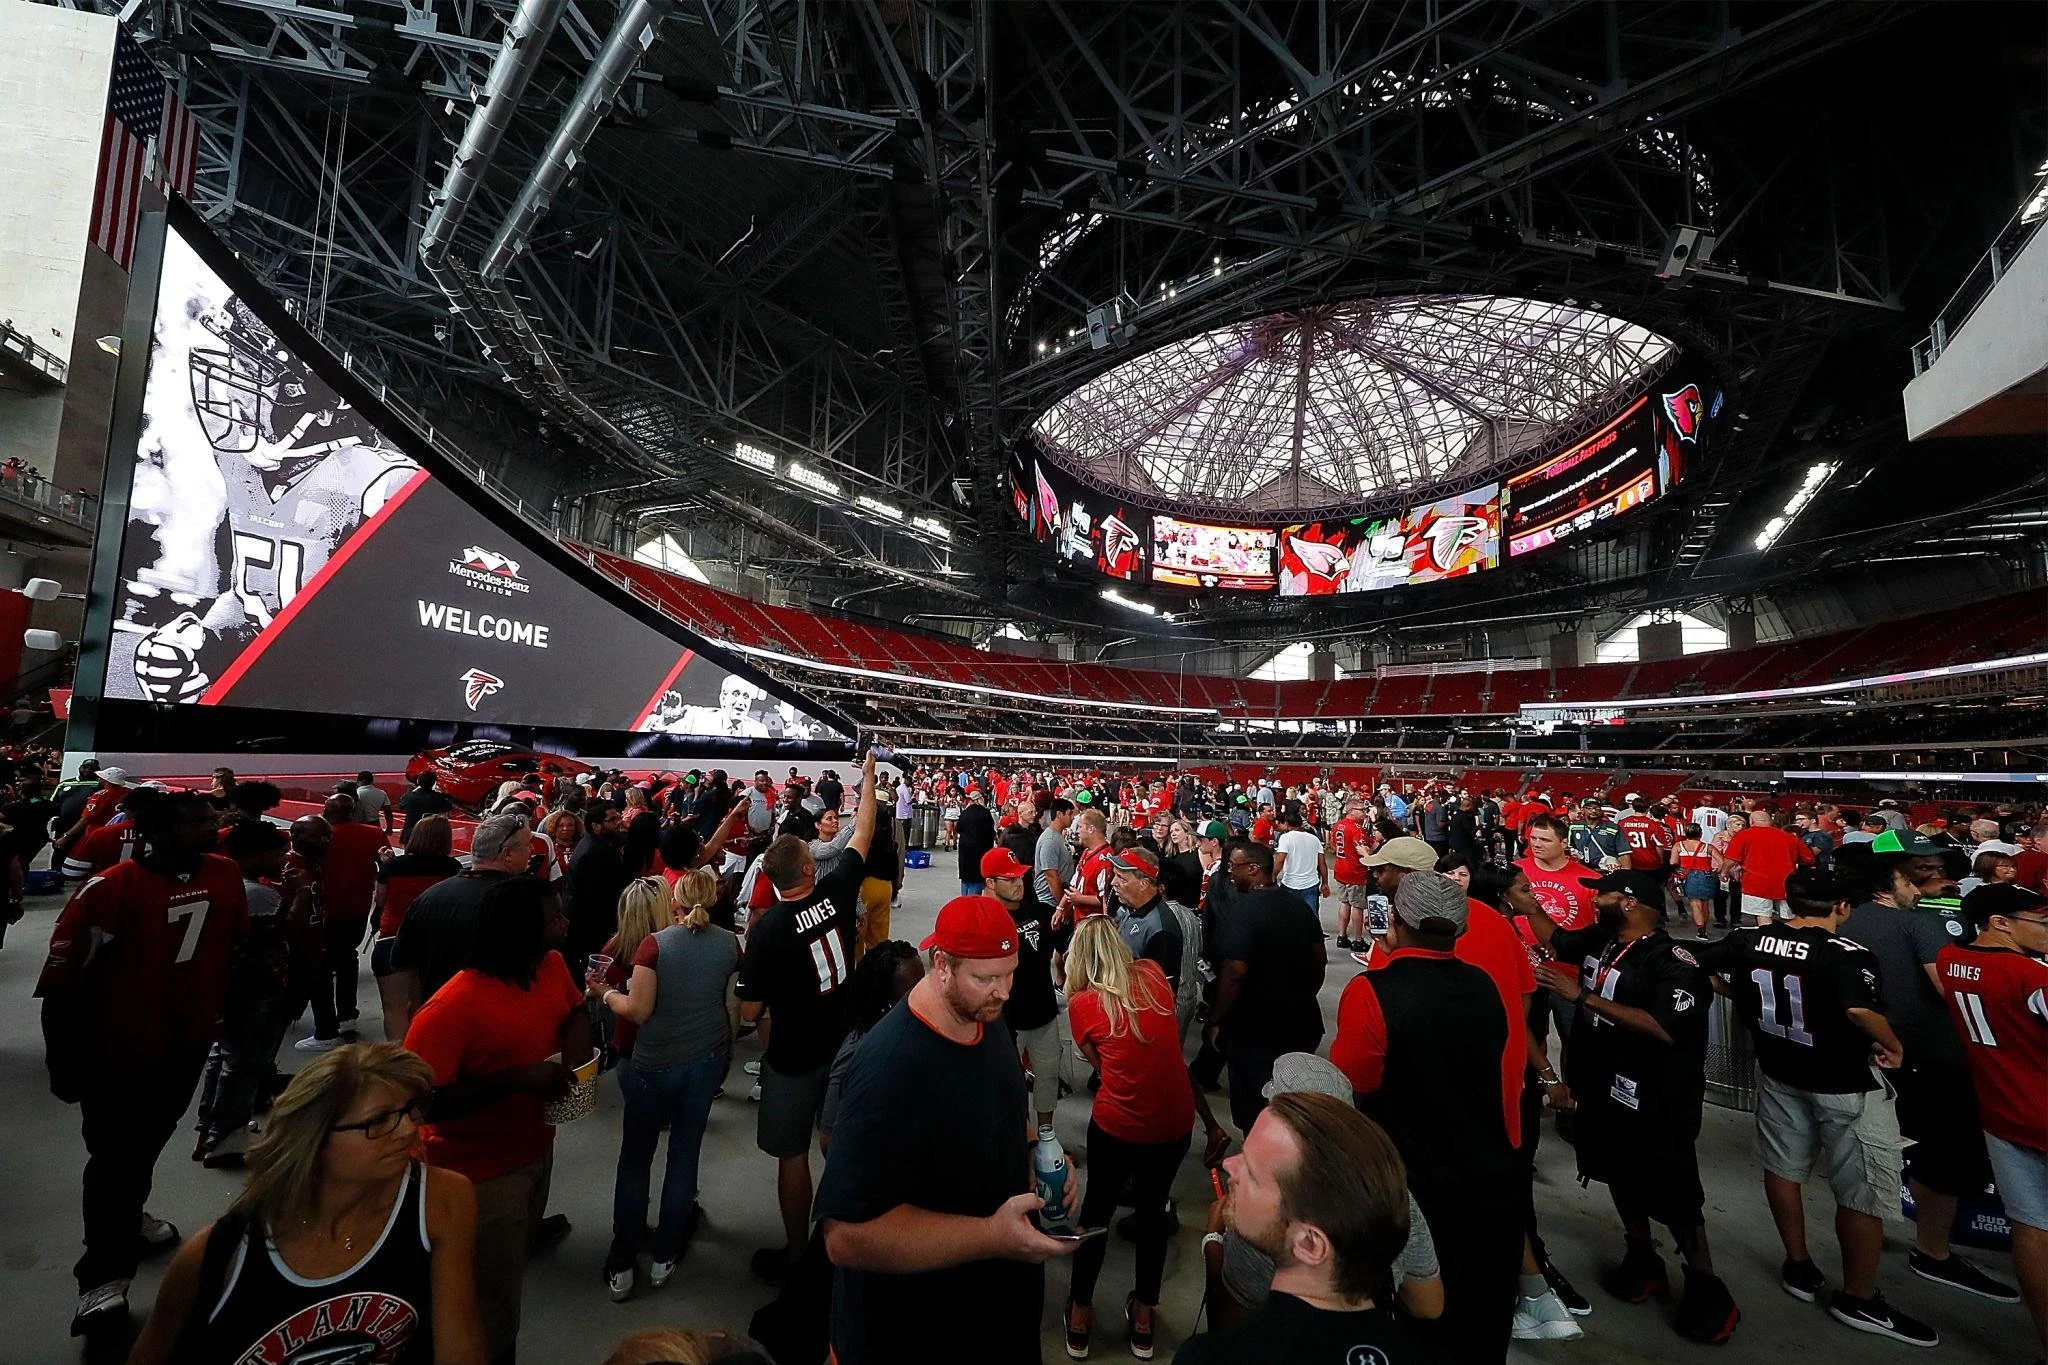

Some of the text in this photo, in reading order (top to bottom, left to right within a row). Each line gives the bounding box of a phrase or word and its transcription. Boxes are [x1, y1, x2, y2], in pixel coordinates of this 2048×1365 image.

[448, 560, 531, 594] Mercedes-Benz
[466, 579, 513, 598] STADIUM
[417, 599, 550, 649] WELCOME
[1627, 831, 1648, 848] 31
[169, 889, 209, 901] FALCONS
[1563, 891, 1579, 926] FOOTBALL
[167, 900, 210, 964] 7
[795, 897, 837, 934] JONES
[809, 928, 847, 993] 11
[1754, 935, 1810, 961] JONES
[1946, 962, 1982, 981] JONES
[1751, 967, 1814, 1047] 11
[1954, 990, 1998, 1047] 11
[1971, 1220, 2012, 1235] LIGHT
[1976, 1213, 2007, 1226] BUD
[232, 1296, 414, 1365] TLANTA
